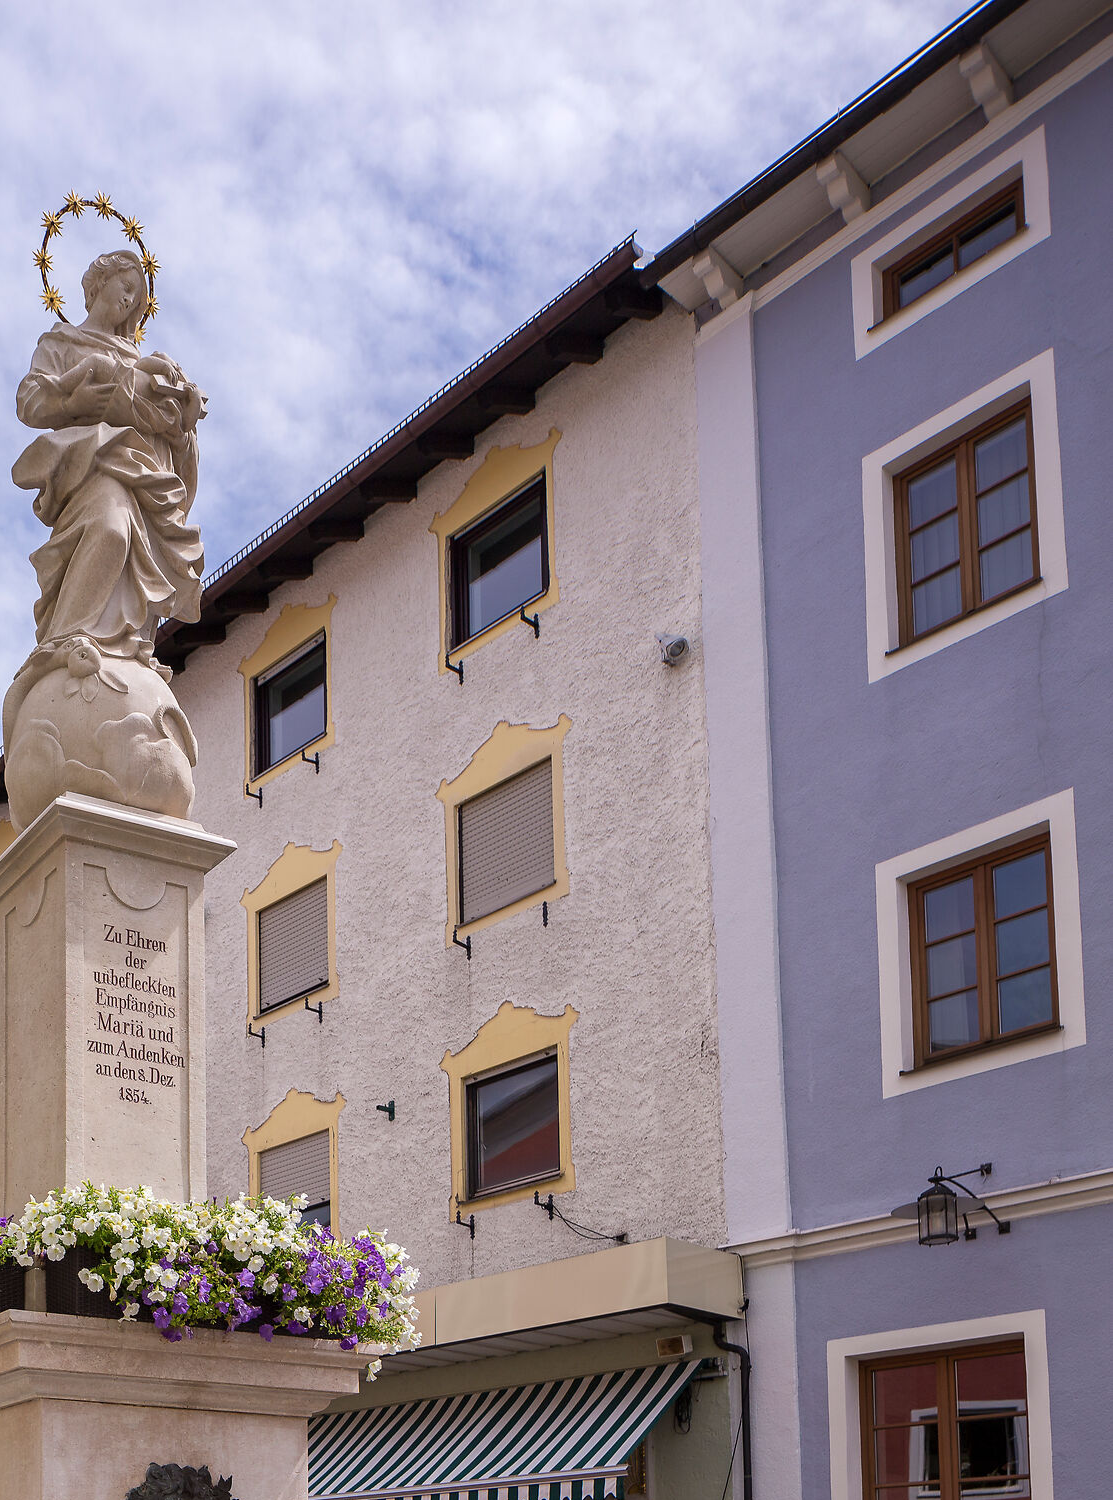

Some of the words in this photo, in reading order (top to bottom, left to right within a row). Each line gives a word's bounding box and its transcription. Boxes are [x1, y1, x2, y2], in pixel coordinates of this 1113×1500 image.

[103, 923, 123, 945] Zu
[125, 928, 167, 953] Ehren
[125, 950, 148, 970] der
[92, 968, 177, 999] unbefleckten
[95, 986, 176, 1019] Empfängnis
[147, 1026, 175, 1044] und
[86, 1039, 115, 1056] zum
[115, 1039, 186, 1069] Andenken
[95, 1062, 113, 1078] an
[113, 1060, 137, 1082] den
[148, 1066, 177, 1088] Dez.
[118, 1086, 153, 1105] 1854.
